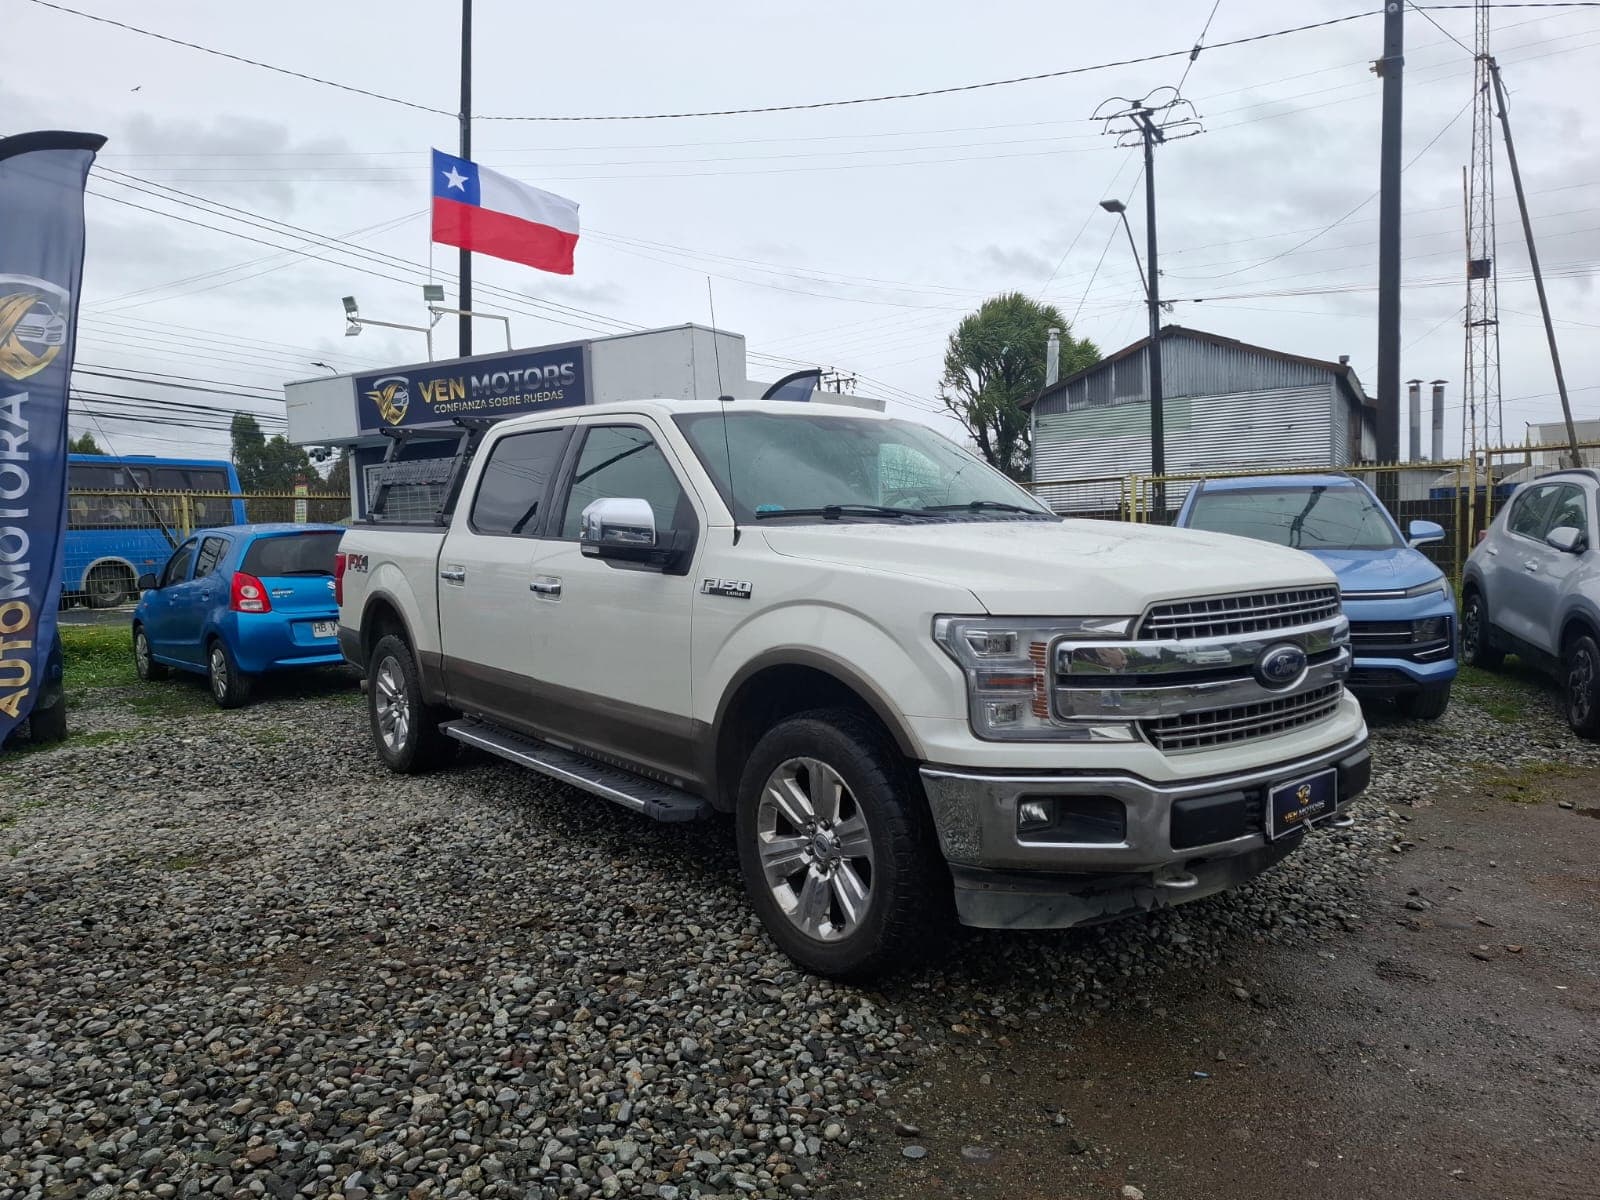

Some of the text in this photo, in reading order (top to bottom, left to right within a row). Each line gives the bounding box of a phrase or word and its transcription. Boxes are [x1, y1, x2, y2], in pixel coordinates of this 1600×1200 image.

[418, 362, 575, 403] VEN MOTORS
[433, 390, 564, 413] CONFIANZA SOBRE RUEDAS
[0, 391, 32, 717] AUTOMOTORA
[1275, 655, 1299, 675] Ford
